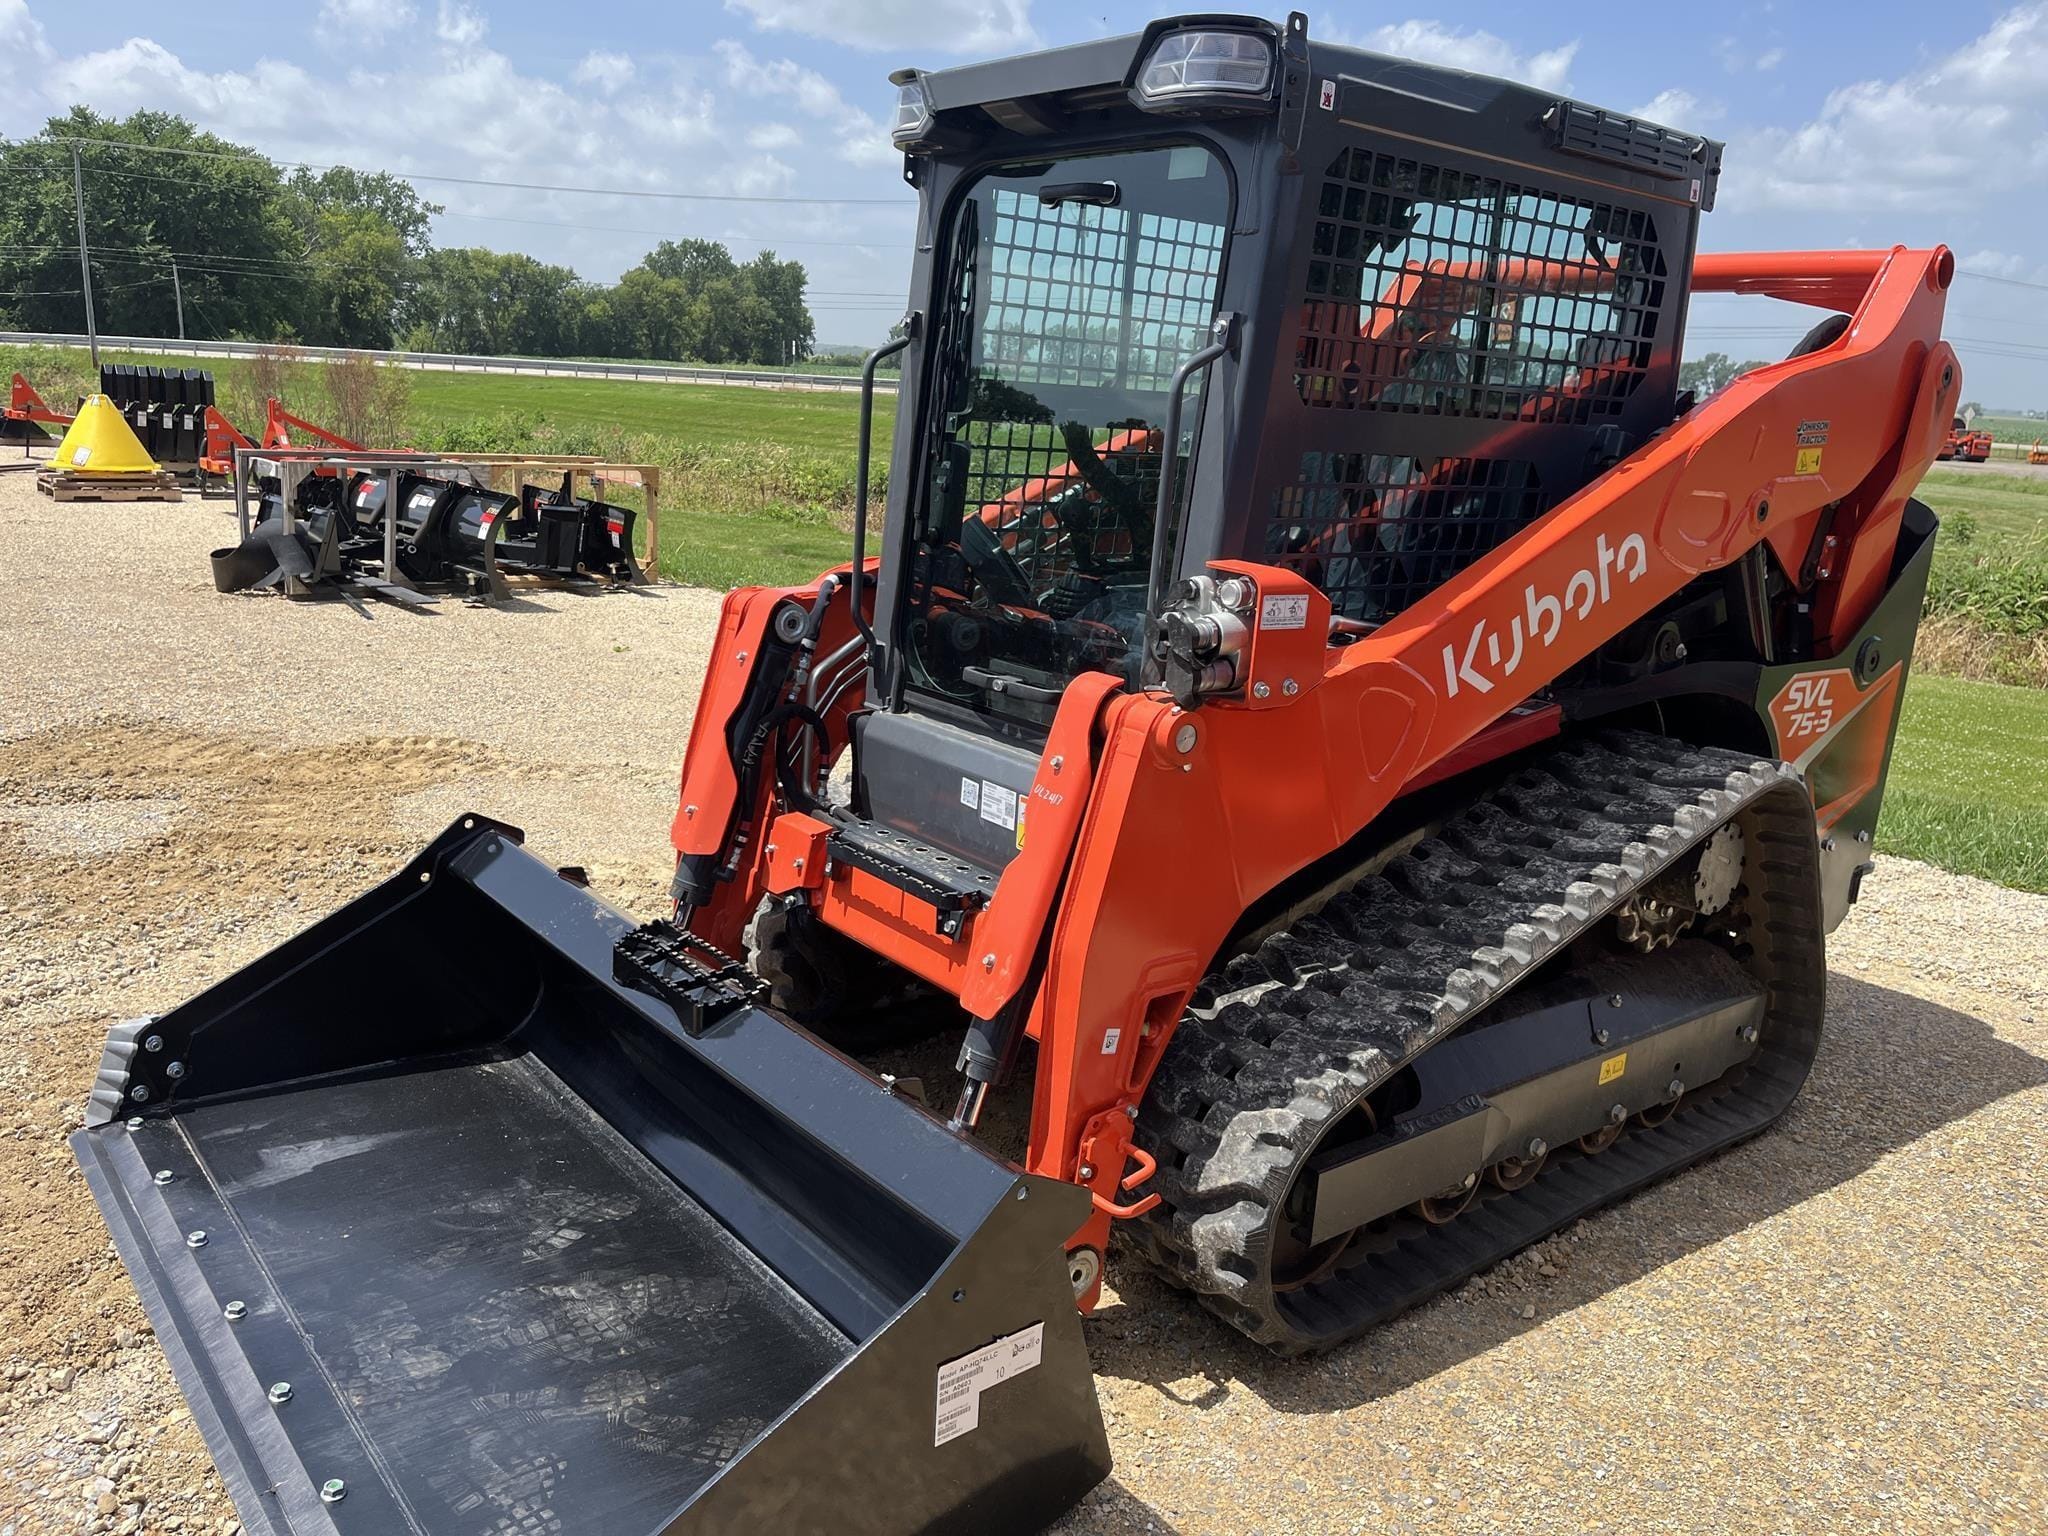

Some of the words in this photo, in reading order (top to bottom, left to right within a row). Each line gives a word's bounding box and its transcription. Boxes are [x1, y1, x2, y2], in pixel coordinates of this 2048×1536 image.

[1442, 533, 1648, 698] Kubota
[1783, 678, 1833, 712] SVL
[1787, 709, 1832, 737] 75-3
